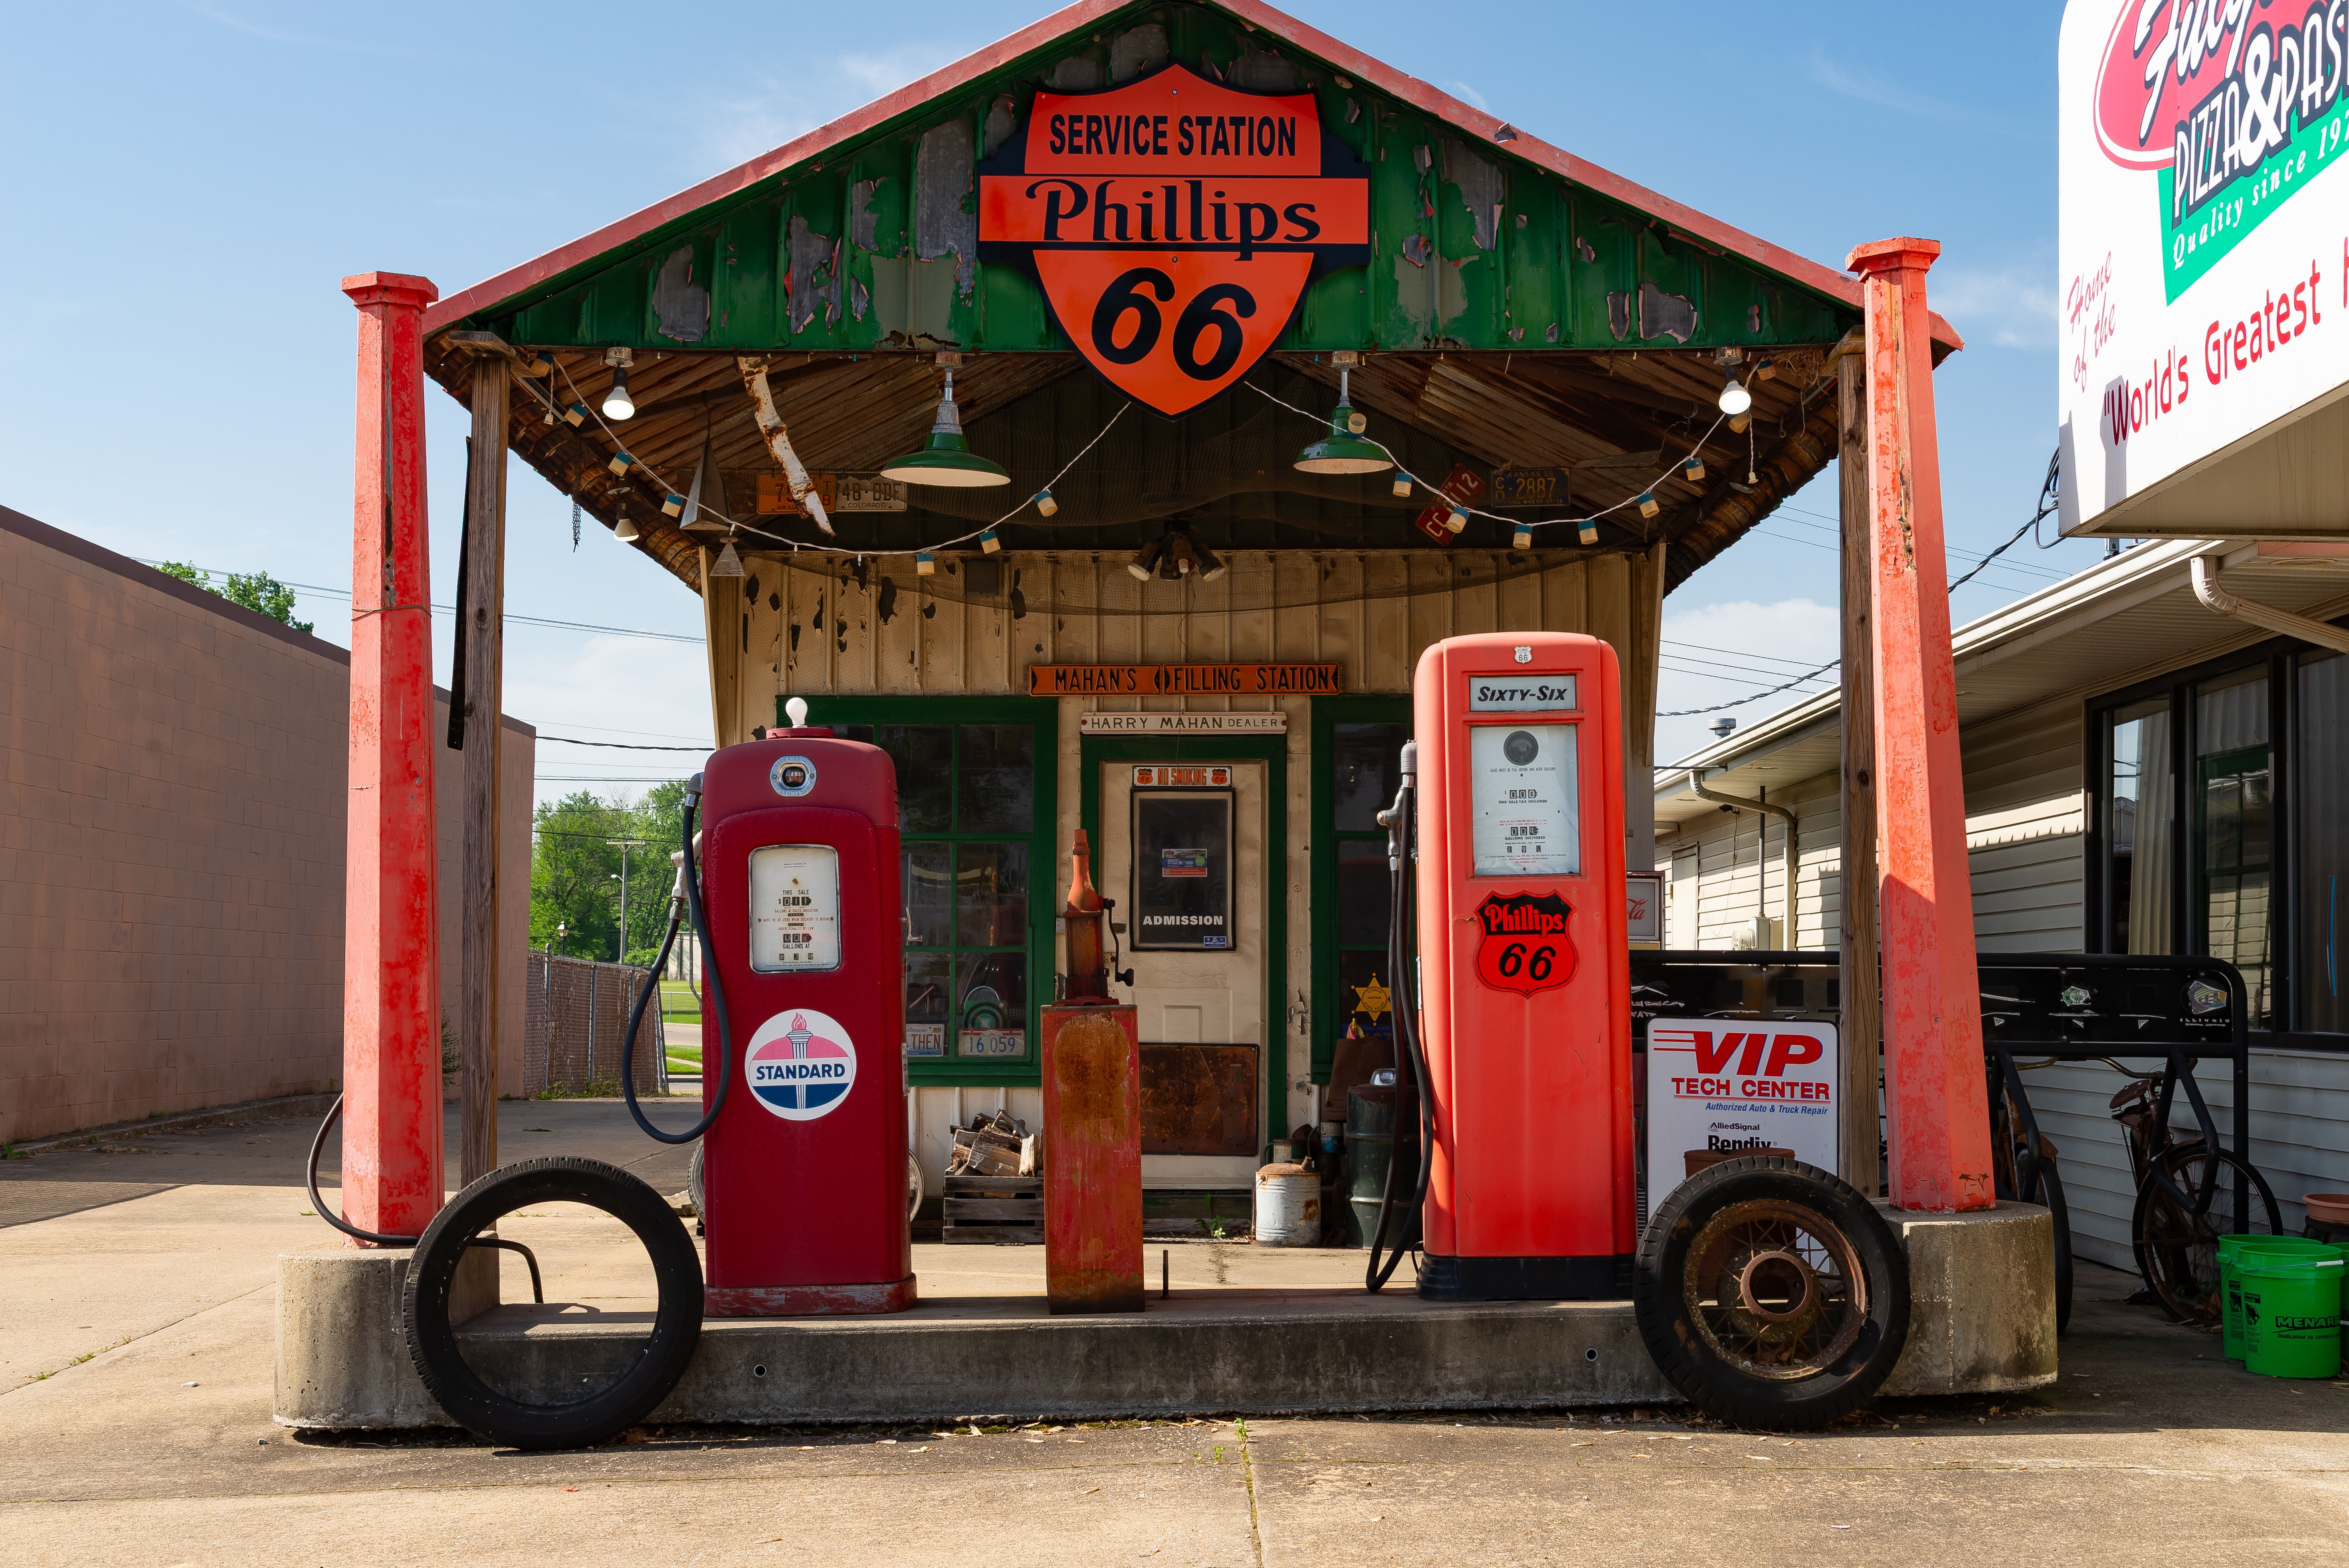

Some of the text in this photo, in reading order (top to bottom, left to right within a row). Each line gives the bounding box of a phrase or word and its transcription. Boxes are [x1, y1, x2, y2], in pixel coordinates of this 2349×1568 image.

[2175, 81, 2240, 218] PIZZA
[2281, 0, 2349, 134] PAS
[1049, 113, 1296, 157] SERVICE STATION
[1025, 178, 1321, 261] Phillips
[2173, 196, 2244, 270] Quality
[2252, 149, 2306, 206] since
[2068, 251, 2111, 335] Home
[1091, 266, 1257, 382] 66
[2205, 259, 2321, 385] Greatest
[2074, 291, 2115, 393] of the
[1055, 667, 1329, 692] MAHAN'S FILLING STATION
[1091, 717, 1277, 729] HARRY MAHAN DEALER
[1158, 768, 1207, 785] NO SMOKING
[1143, 915, 1223, 925] ADMISSION
[1484, 904, 1563, 937] Phillips
[1498, 942, 1557, 981] 66
[1364, 1002, 1385, 1010] STATE POLICE
[911, 1034, 941, 1050] THEN
[969, 1036, 1016, 1053] 16 059
[1693, 1031, 1823, 1077] VIP
[756, 1063, 846, 1080] STANDARD
[1671, 1077, 1830, 1100] TECH CENTER
[1705, 1102, 1828, 1116] Authorized Auto & Truck Repair
